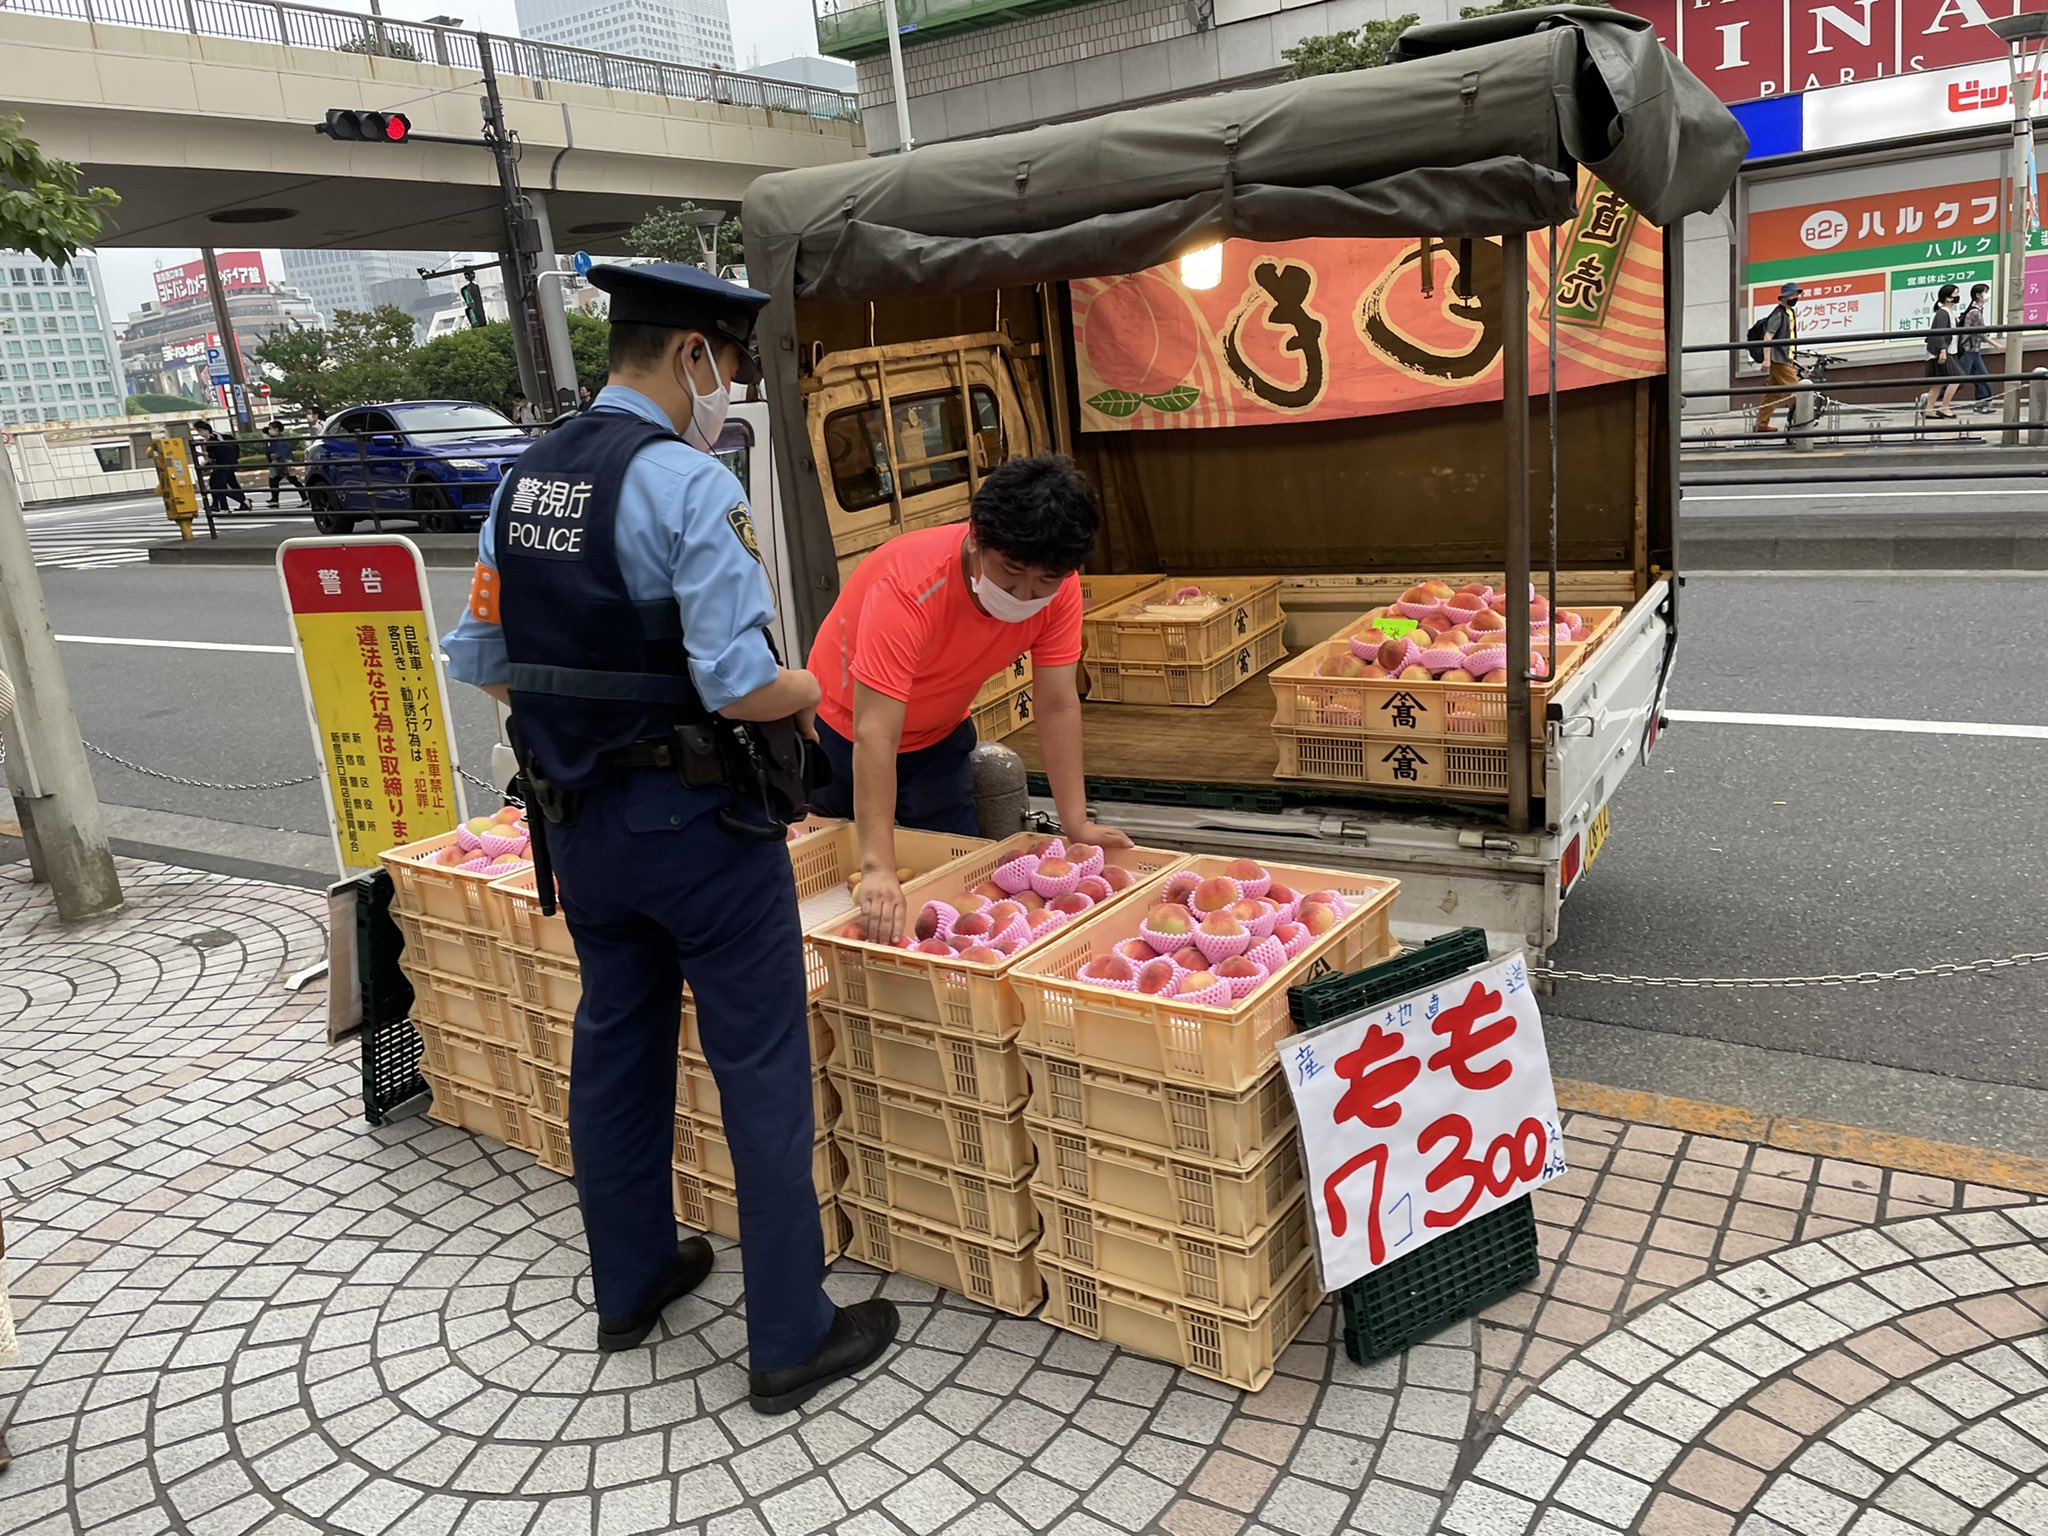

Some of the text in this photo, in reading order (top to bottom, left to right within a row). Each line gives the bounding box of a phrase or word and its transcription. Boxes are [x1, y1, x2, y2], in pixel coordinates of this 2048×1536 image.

[1761, 55, 1925, 97] PARIS
[1805, 220, 1844, 241] B2F
[1799, 284, 1853, 298] 営業フロア
[1899, 316, 1931, 331] 地下1
[207, 349, 220, 364] P
[511, 477, 593, 518] 警視庁
[508, 522, 583, 552] POLICE
[317, 567, 382, 595] 警告
[387, 625, 423, 762] 客引き・勧誘行為は
[404, 625, 433, 732] 自転車・バイク
[1333, 980, 1518, 1129] もも
[1417, 1113, 1547, 1228] 300
